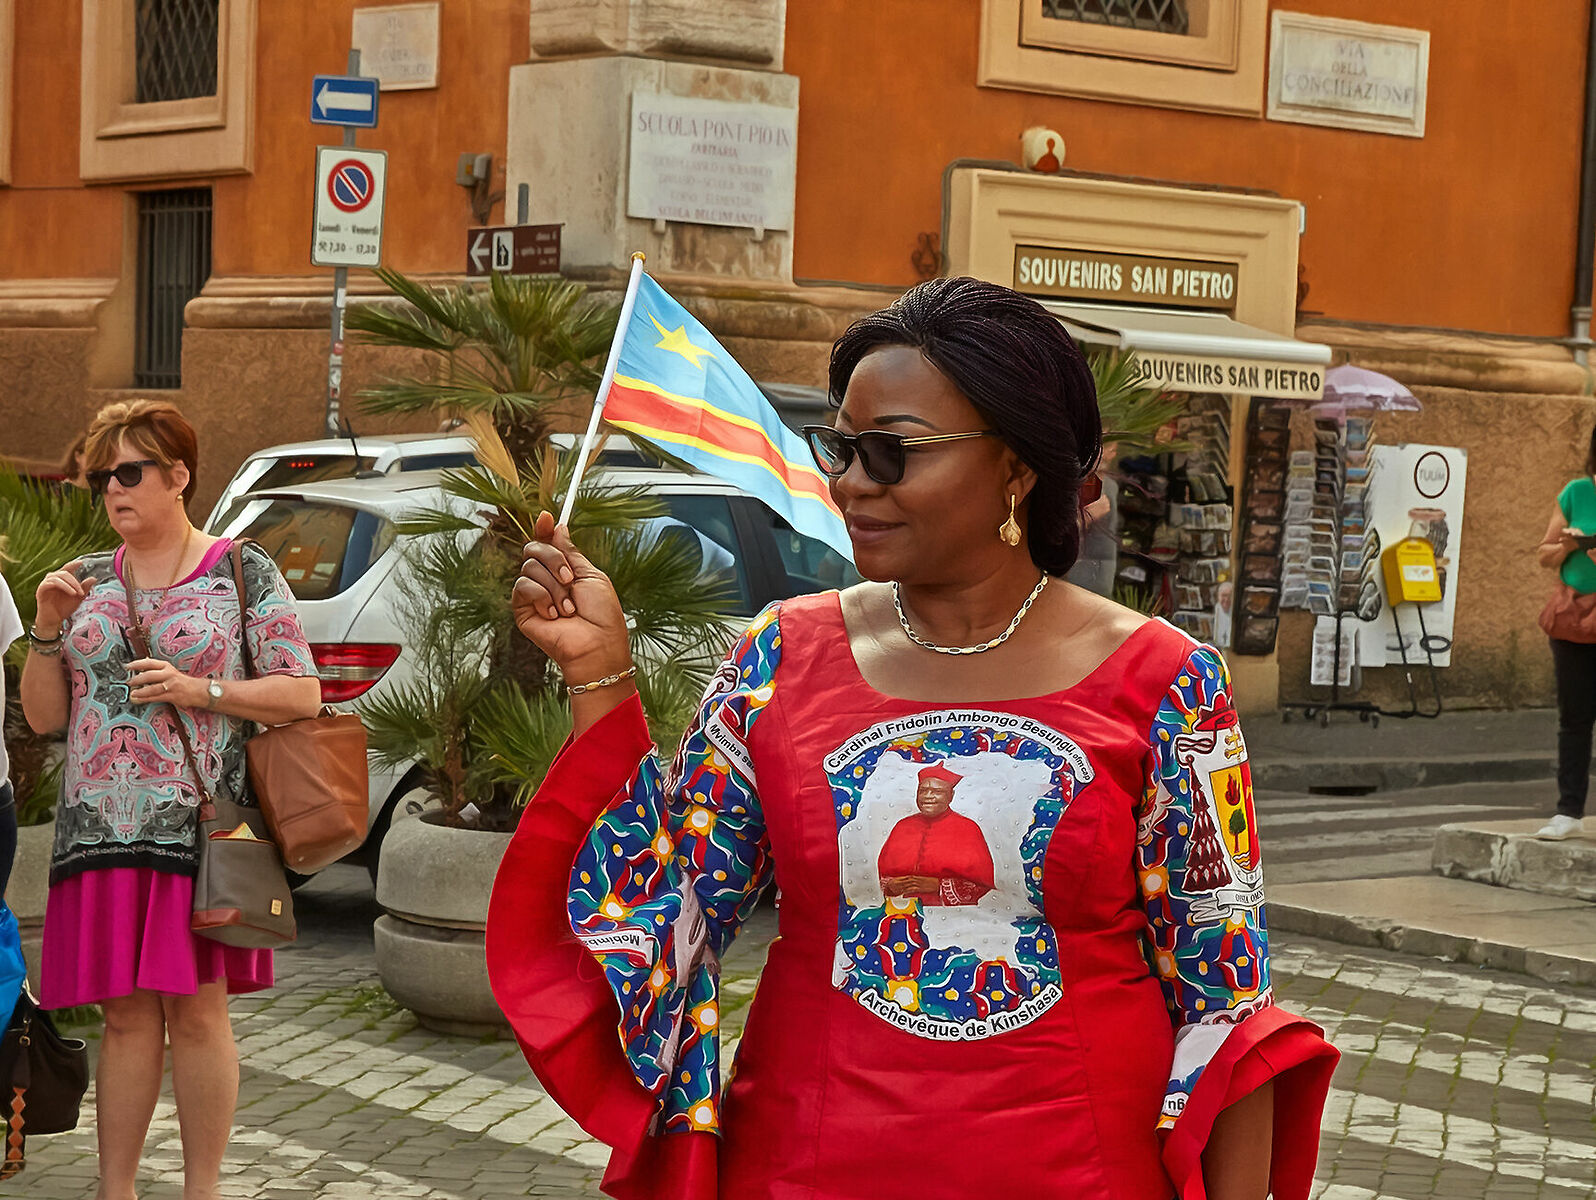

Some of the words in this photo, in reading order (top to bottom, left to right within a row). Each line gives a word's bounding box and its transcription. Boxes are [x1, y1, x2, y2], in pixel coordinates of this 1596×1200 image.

[1335, 39, 1365, 59] VIA
[1331, 60, 1368, 77] DELLA
[1284, 72, 1413, 105] CONCILIAZIONE
[638, 111, 698, 137] SCUOLA
[748, 124, 773, 145] PIO
[1019, 256, 1123, 292] SOUVENIRS
[1131, 265, 1168, 296] SAN
[1172, 268, 1235, 300] PIETRO
[1131, 357, 1224, 386] SOUVENIRS
[1228, 364, 1260, 389] SAN
[1265, 366, 1321, 393] PIETRO
[828, 727, 884, 769] Cardinal
[886, 714, 942, 735] Fridolin
[946, 711, 1019, 728] Ambongo
[1020, 719, 1076, 756] Besungu,
[864, 991, 960, 1037] Archevêque
[965, 1023, 987, 1037] de
[991, 986, 1060, 1032] Kinshasa
